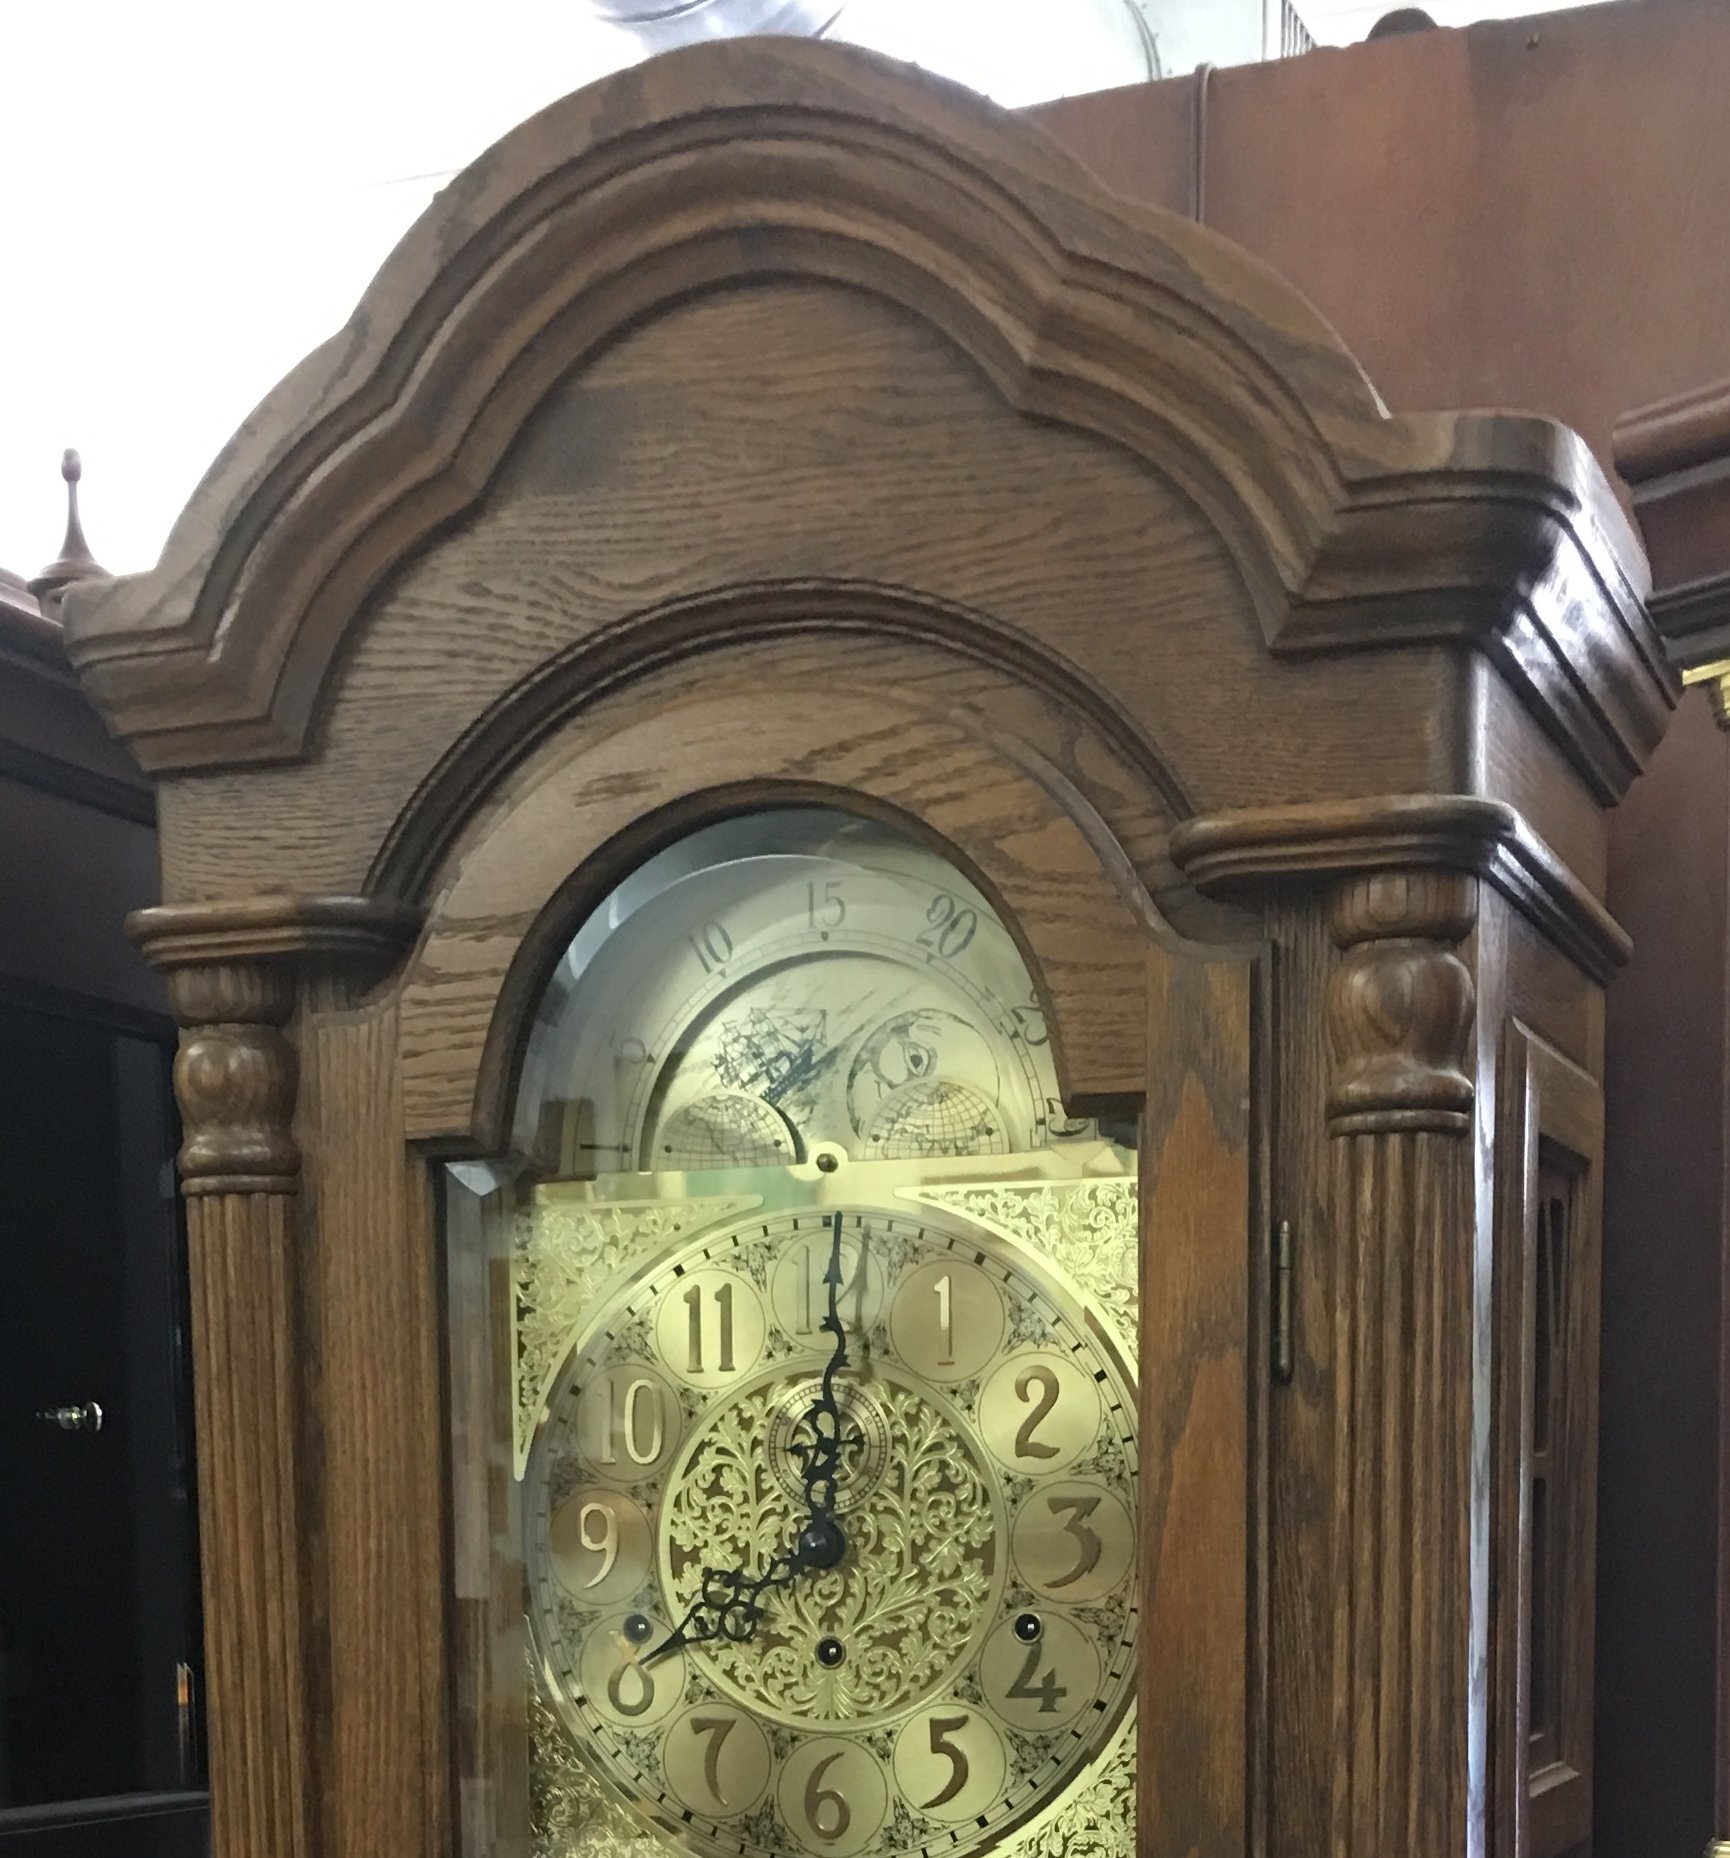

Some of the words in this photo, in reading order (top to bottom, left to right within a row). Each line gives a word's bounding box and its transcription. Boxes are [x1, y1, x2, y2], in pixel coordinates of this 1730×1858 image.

[688, 919, 734, 975] 10
[806, 880, 847, 928] 15
[915, 894, 978, 958] 20
[682, 1281, 736, 1375] 11
[931, 1273, 956, 1367] 1
[600, 1376, 664, 1467] 10
[1013, 1363, 1060, 1459] 2
[579, 1501, 619, 1590] 9
[1045, 1495, 1103, 1590] 3
[607, 1628, 656, 1717] 8
[1004, 1637, 1068, 1713] 4
[690, 1716, 738, 1806] 7
[805, 1751, 851, 1840] 6
[919, 1712, 971, 1810] 5
